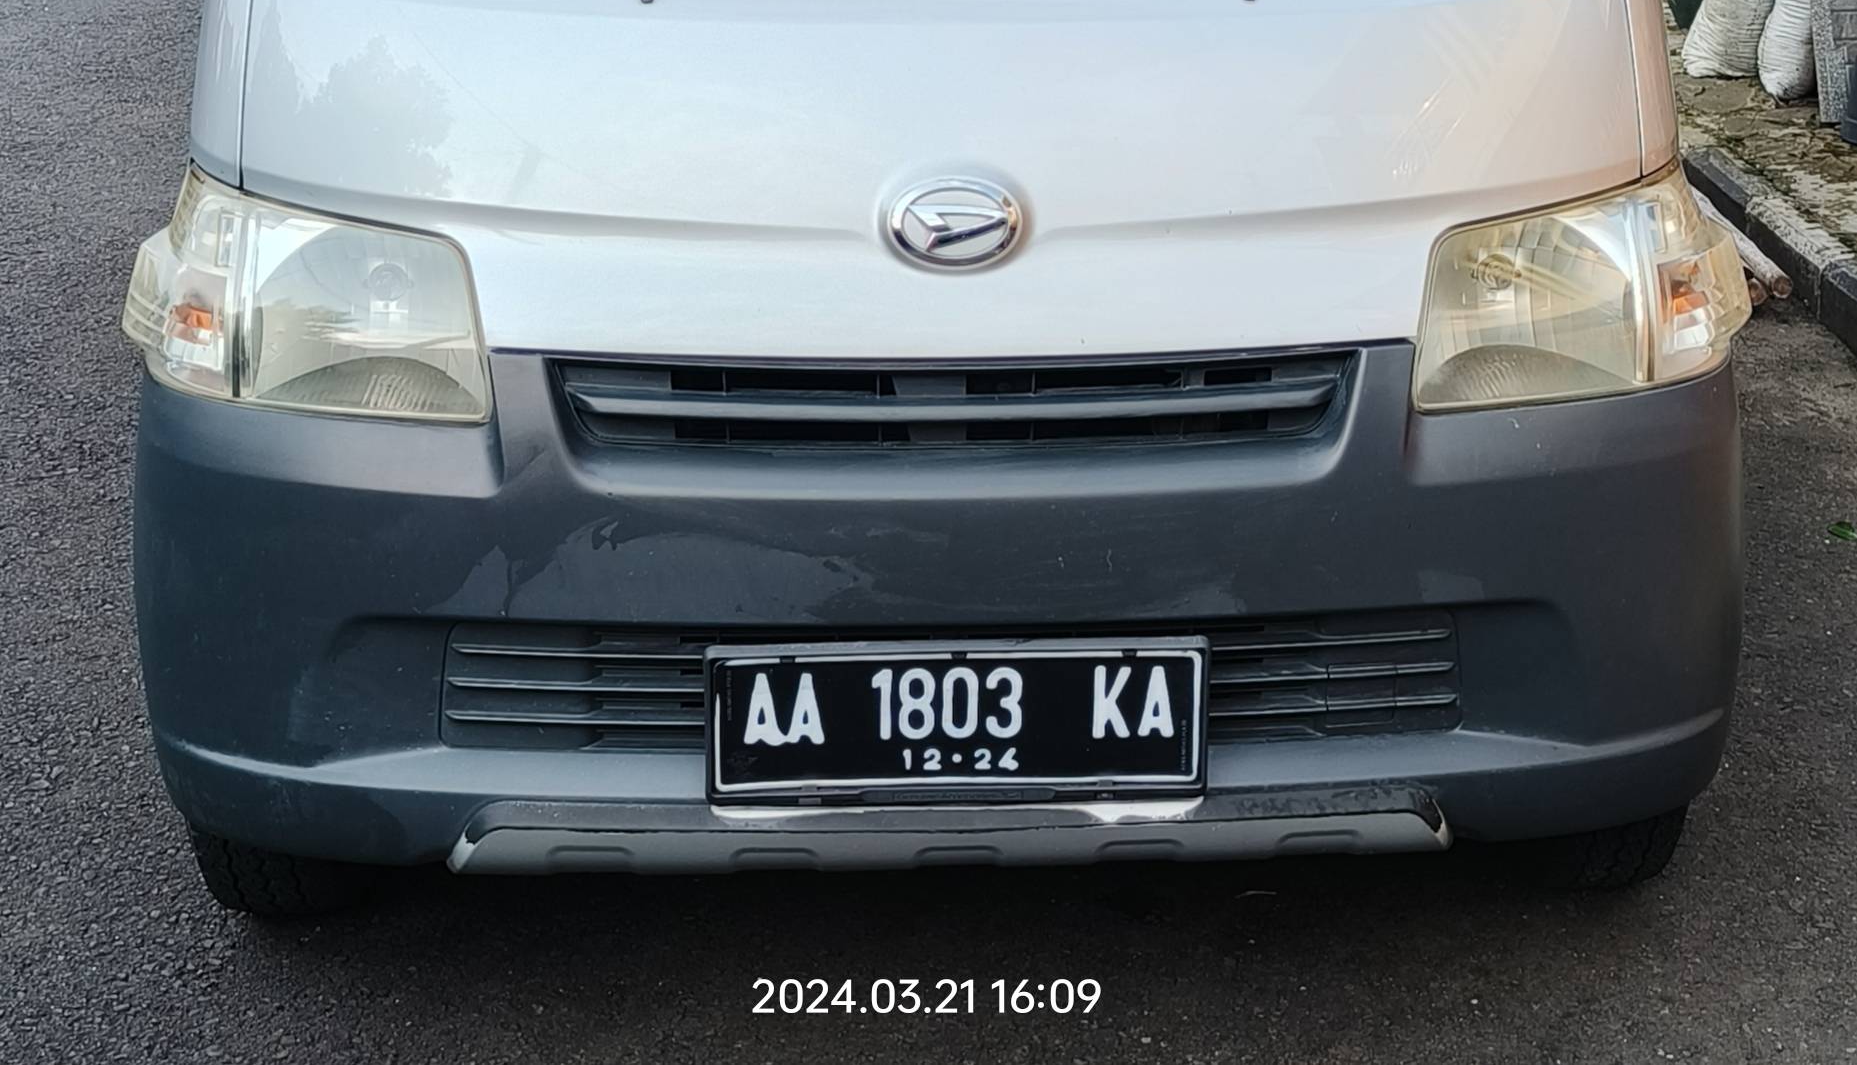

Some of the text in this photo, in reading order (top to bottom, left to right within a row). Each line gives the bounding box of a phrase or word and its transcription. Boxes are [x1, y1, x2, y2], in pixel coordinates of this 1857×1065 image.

[744, 672, 825, 746] AA
[871, 666, 1023, 740] 1803
[1092, 665, 1175, 739] KA
